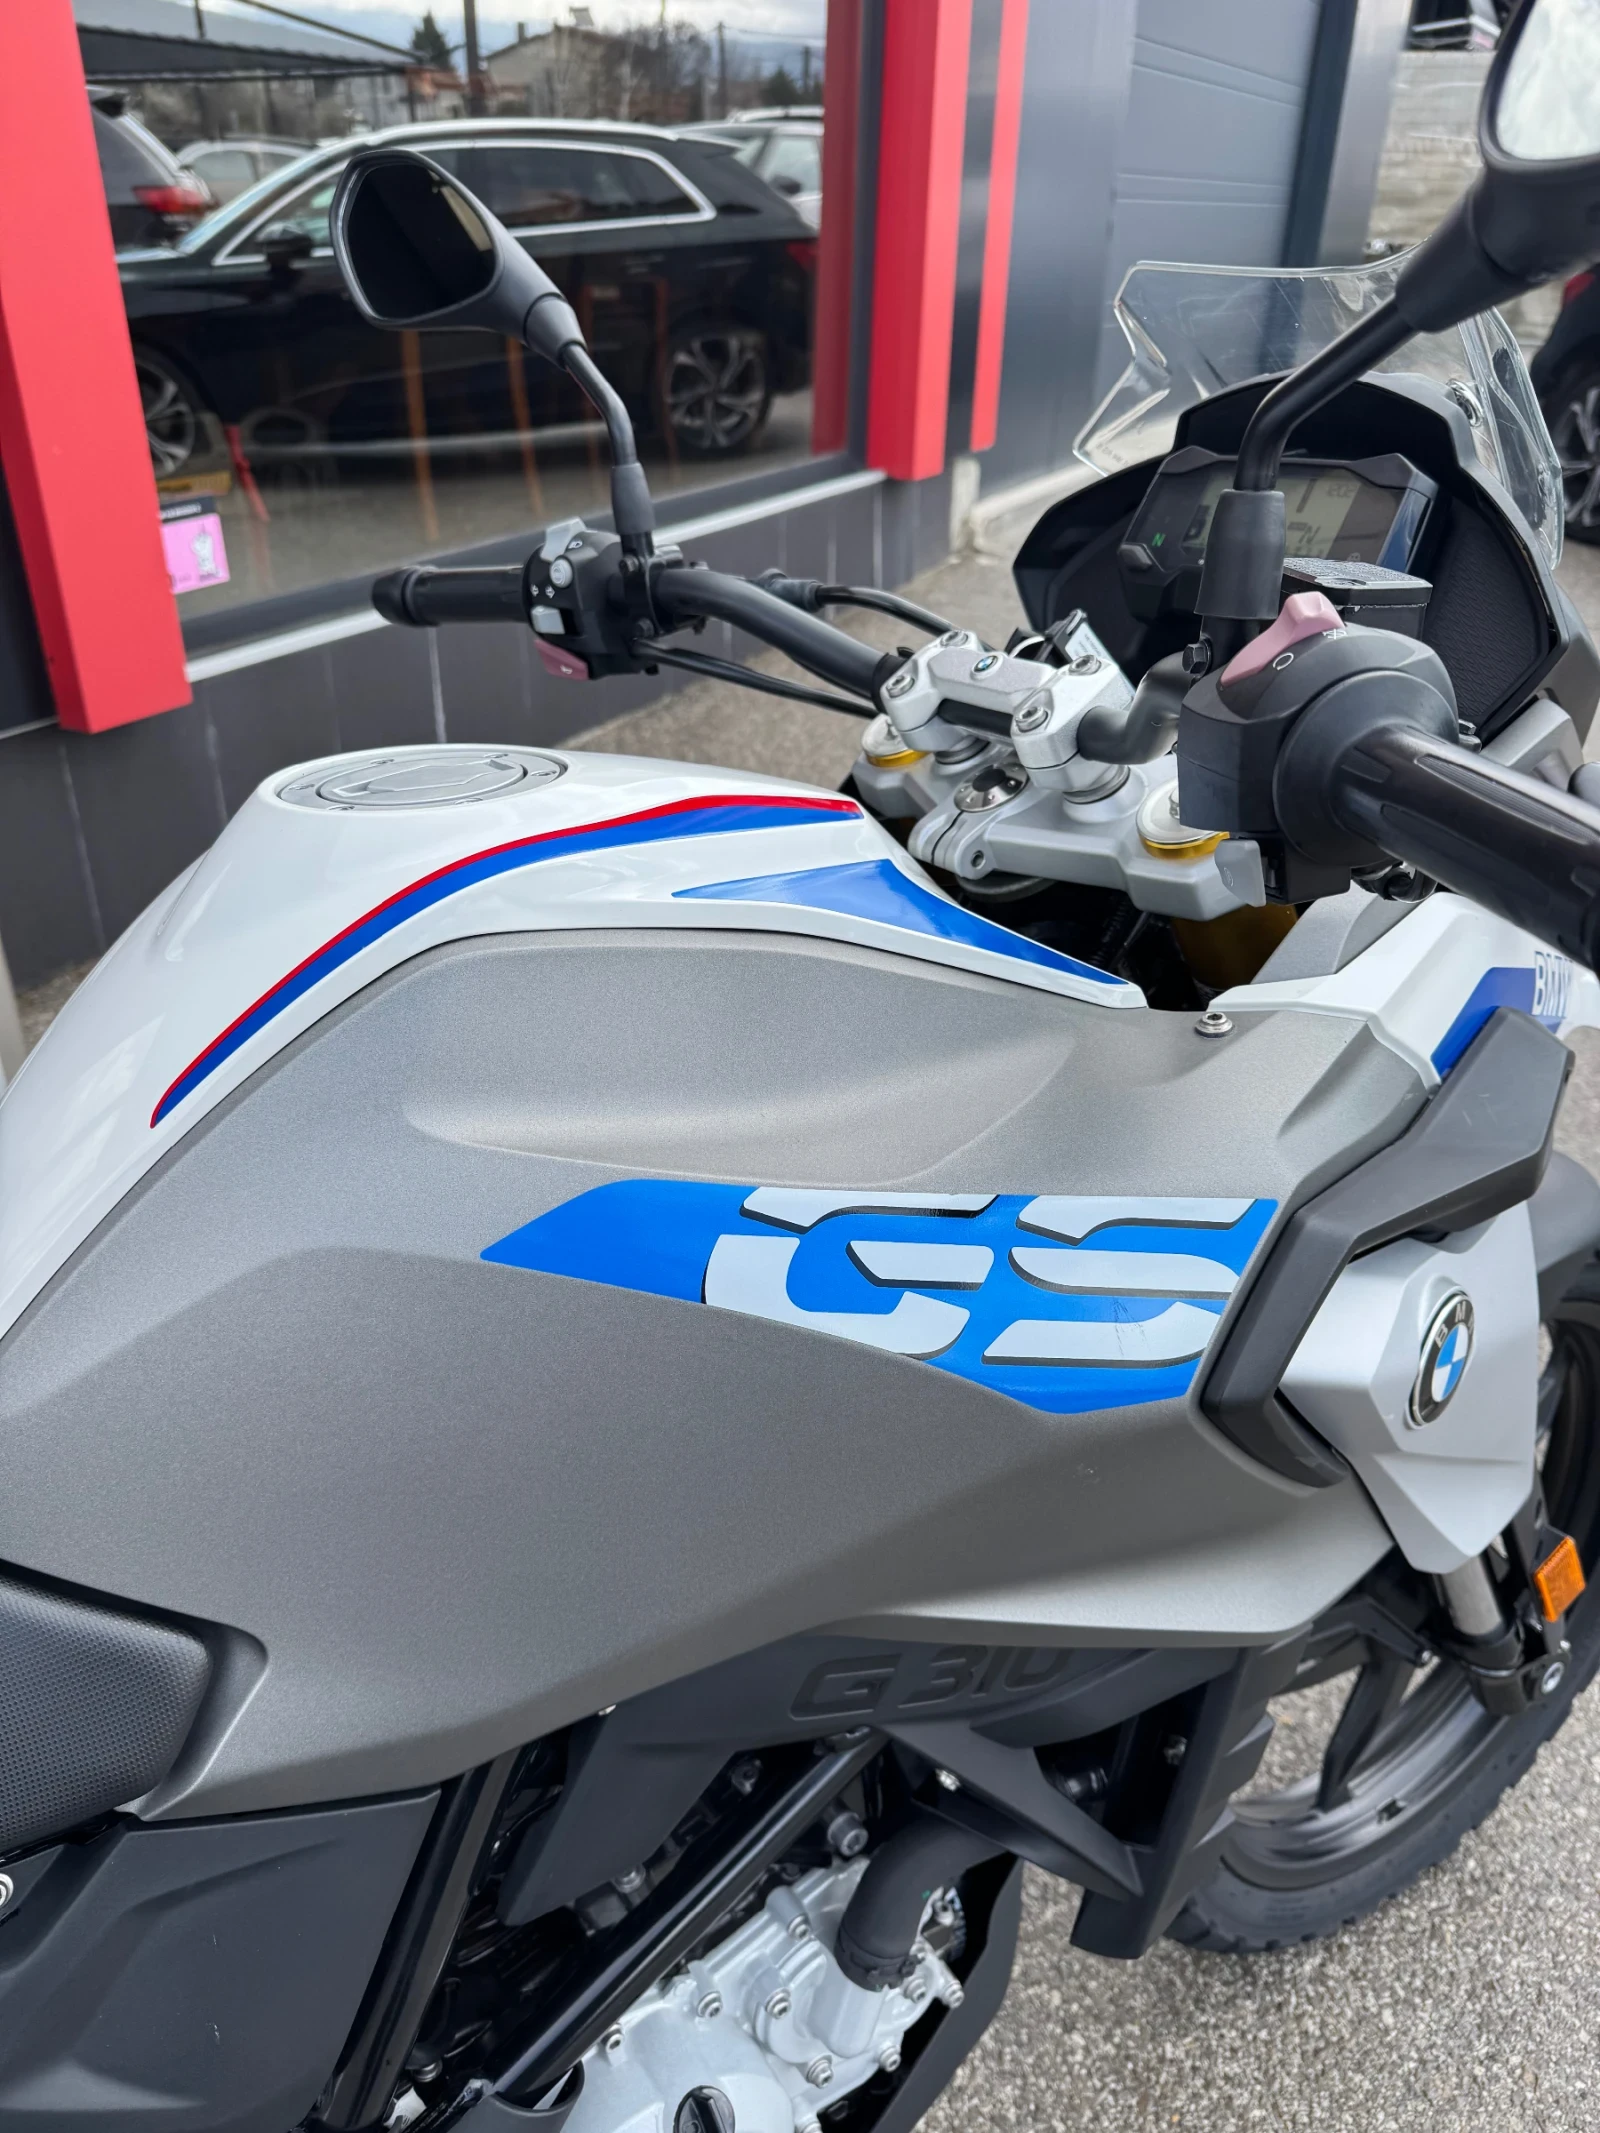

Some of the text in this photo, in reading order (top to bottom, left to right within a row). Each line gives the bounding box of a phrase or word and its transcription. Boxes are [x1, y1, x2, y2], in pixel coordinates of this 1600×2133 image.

[1152, 532, 1167, 547] N
[702, 1186, 1241, 1370] GS
[1434, 1299, 1474, 1349] BMW
[788, 1644, 1075, 1721] G 310
